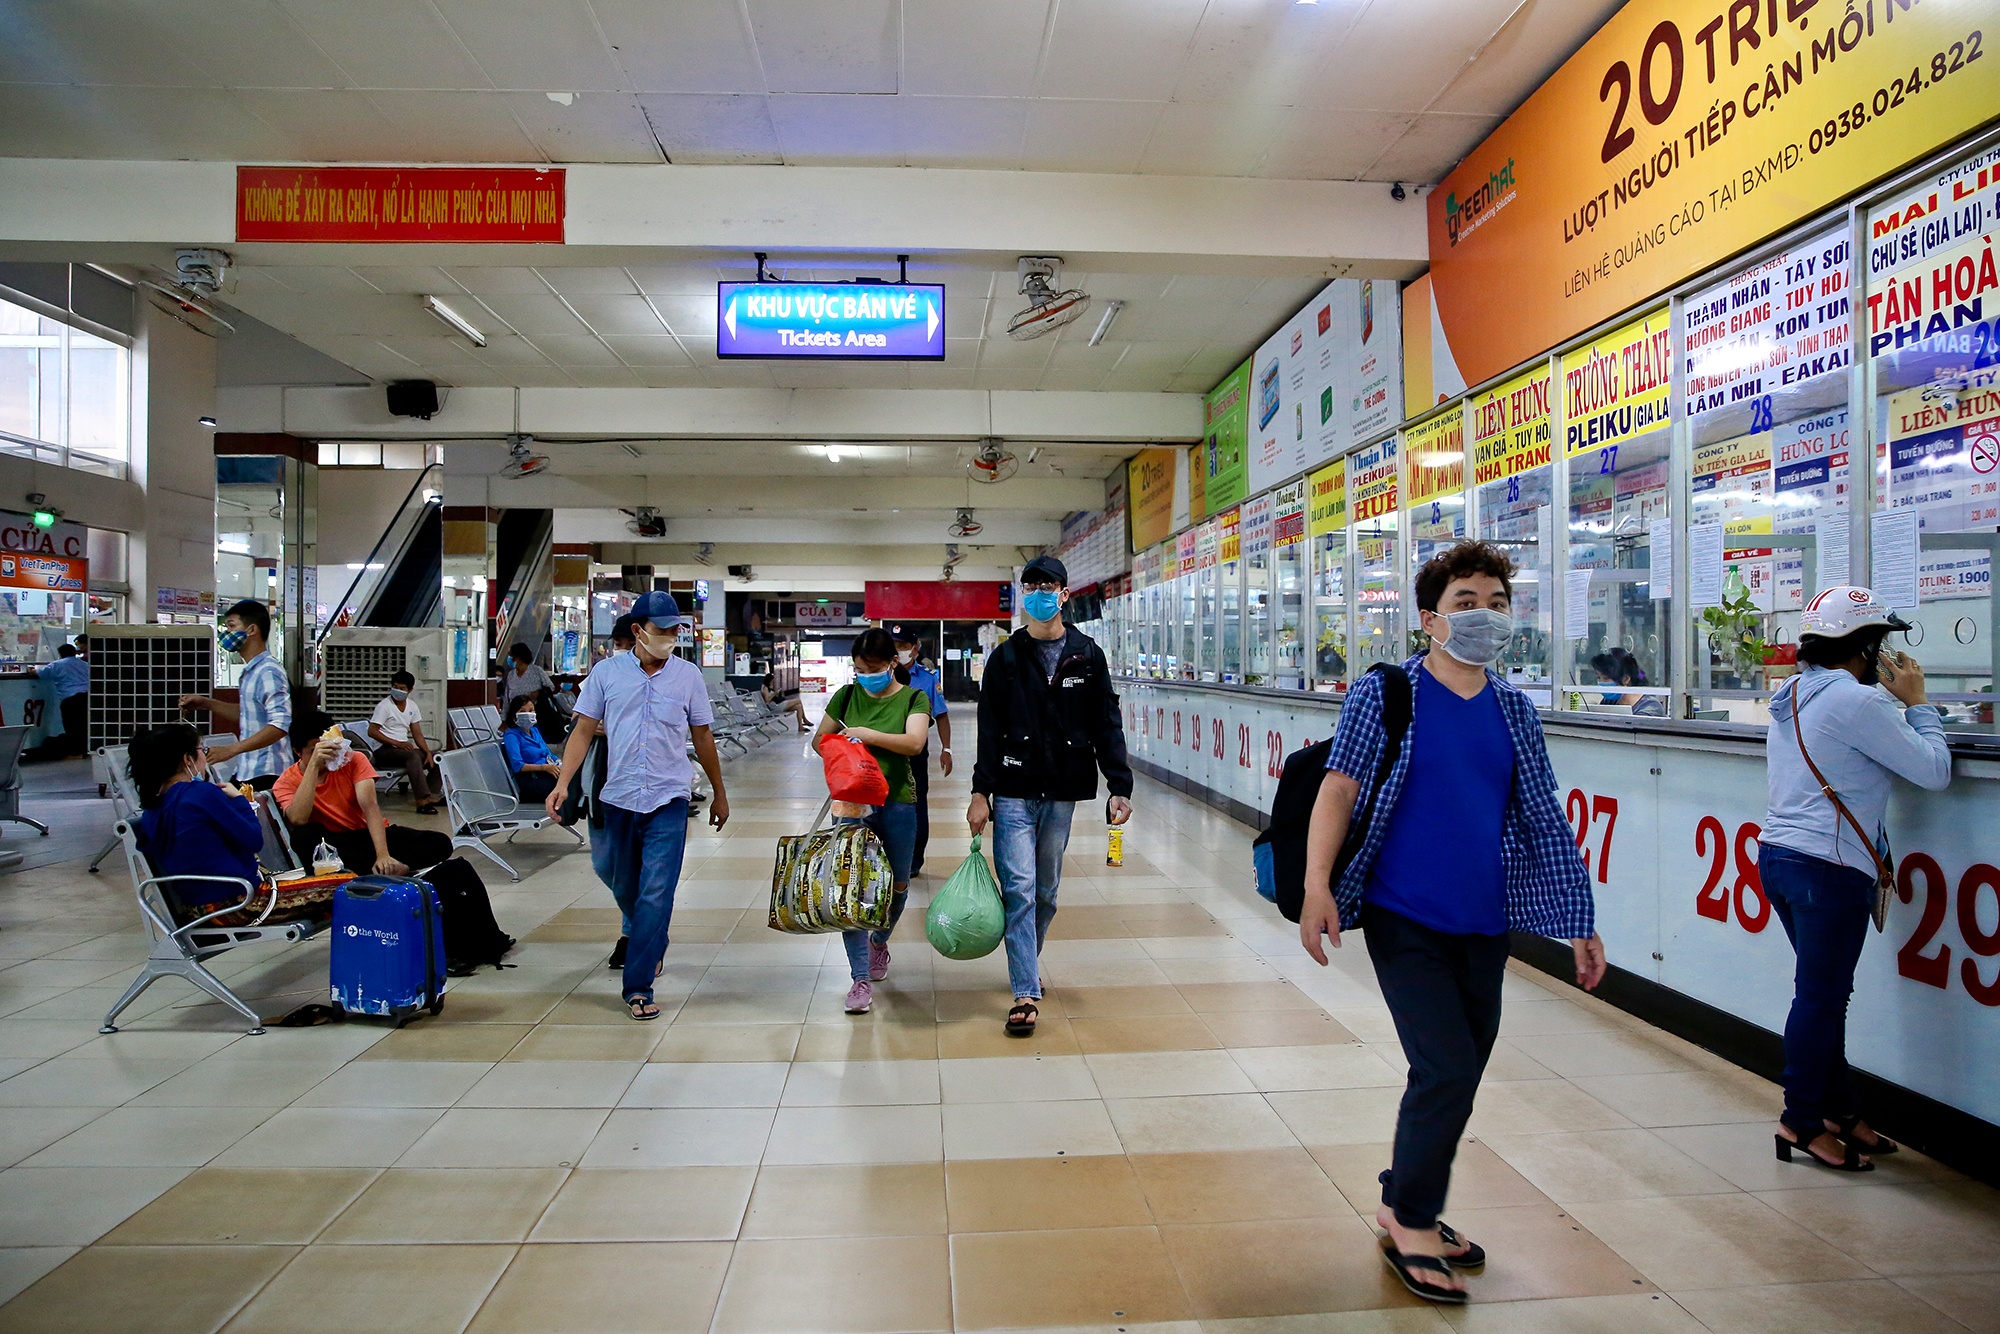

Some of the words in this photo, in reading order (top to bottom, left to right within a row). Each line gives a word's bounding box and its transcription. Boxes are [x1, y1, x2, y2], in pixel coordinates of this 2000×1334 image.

[1600, 21, 1684, 163] 20
[1563, 189, 1609, 244] LƯỢT
[1613, 140, 1680, 210] NGƯỜI
[1685, 99, 1737, 159] TIẾP
[1743, 50, 1803, 118] CẬN
[1564, 269, 1591, 299] LIÊN
[1594, 252, 1611, 283] HỆ
[1613, 224, 1666, 268] QUẢNG
[1669, 201, 1704, 237] CÁO
[1709, 179, 1737, 212] TẠI
[1743, 143, 1803, 196] BXMĐ:
[1808, 30, 1983, 155] 0938.024.822
[245, 180, 282, 222] KHÔNG
[286, 174, 302, 223] ĐỂ
[329, 188, 343, 223] RA
[347, 181, 379, 231] CHÁY,
[382, 173, 401, 224] NỔ
[401, 181, 415, 224] LÀ
[418, 189, 449, 231] HẠNH
[453, 182, 483, 224] PHÚC
[485, 178, 508, 224] CỦA
[510, 190, 532, 231] MỌI
[534, 183, 557, 224] NHÀ
[1872, 192, 1938, 240] MAI
[1871, 233, 1898, 274] CHƯ
[1900, 225, 1918, 263] SÊ
[1921, 215, 1951, 258] (GIA
[1954, 200, 1983, 239] LAI)
[1686, 296, 1728, 330] THÀNH
[1732, 277, 1771, 311] NHÂN
[1785, 256, 1817, 286] TÂY
[1867, 276, 1923, 335] TÂN
[1932, 234, 1999, 311] HOÀ
[747, 295, 792, 318] KHU
[794, 293, 839, 324] VỰC
[843, 292, 887, 320] BÁN
[887, 293, 917, 320] VÉ
[1730, 301, 1771, 339] GIANG
[1785, 283, 1815, 311] TUY
[777, 329, 841, 347] Tickets
[844, 330, 887, 348] Area
[1775, 313, 1810, 341] KON
[1871, 296, 1983, 358] PHAN
[1565, 344, 1619, 420] TRƯỜNG
[1687, 375, 1706, 397] LONG
[1973, 370, 1997, 388] TY
[1687, 390, 1725, 417] LÂM
[1731, 378, 1762, 401] NHI
[1474, 392, 1508, 441] LIÊN
[1566, 404, 1632, 453] PLEIKU
[1750, 394, 1773, 436] 28
[1798, 414, 1834, 436] CÔNG
[1901, 404, 1948, 434] LIÊN
[1967, 424, 1983, 436] GIÁ
[1984, 421, 1997, 432] VÉ
[1353, 448, 1380, 472] Thuận
[1475, 443, 1491, 467] VẠN
[1515, 427, 1533, 451] TUY
[1600, 445, 1619, 475] 27
[1697, 447, 1724, 460] CÔNG
[1726, 442, 1739, 453] TY
[1706, 455, 1728, 472] TIẾN
[1730, 456, 1746, 467] GIA
[1749, 449, 1765, 463] LAI
[1780, 437, 1824, 463] HƯNG
[1897, 443, 1924, 461] TUYẾN
[1352, 467, 1385, 488] PLEIKU
[1475, 462, 1502, 485] NHA
[1508, 475, 1520, 503] 26
[1780, 470, 1800, 486] TUYẾN
[1930, 489, 1953, 502] TRANG
[1, 522, 57, 555] CỬA
[64, 536, 80, 557] C
[1275, 536, 1290, 548] KON
[19, 557, 70, 573] VietTanPhat
[1958, 570, 1990, 584] 1900
[799, 603, 828, 617] CỬA
[833, 607, 842, 617] E
[23, 698, 46, 727] 87
[1173, 710, 1182, 746] 18
[1192, 714, 1201, 752] 19
[1213, 718, 1225, 761] 20
[1238, 723, 1251, 769] 21
[1267, 729, 1284, 780] 22
[1567, 787, 1619, 884] 27
[1695, 815, 1772, 934] 28
[358, 928, 372, 937] the
[373, 929, 400, 940] World
[1896, 852, 2000, 1007] 29
